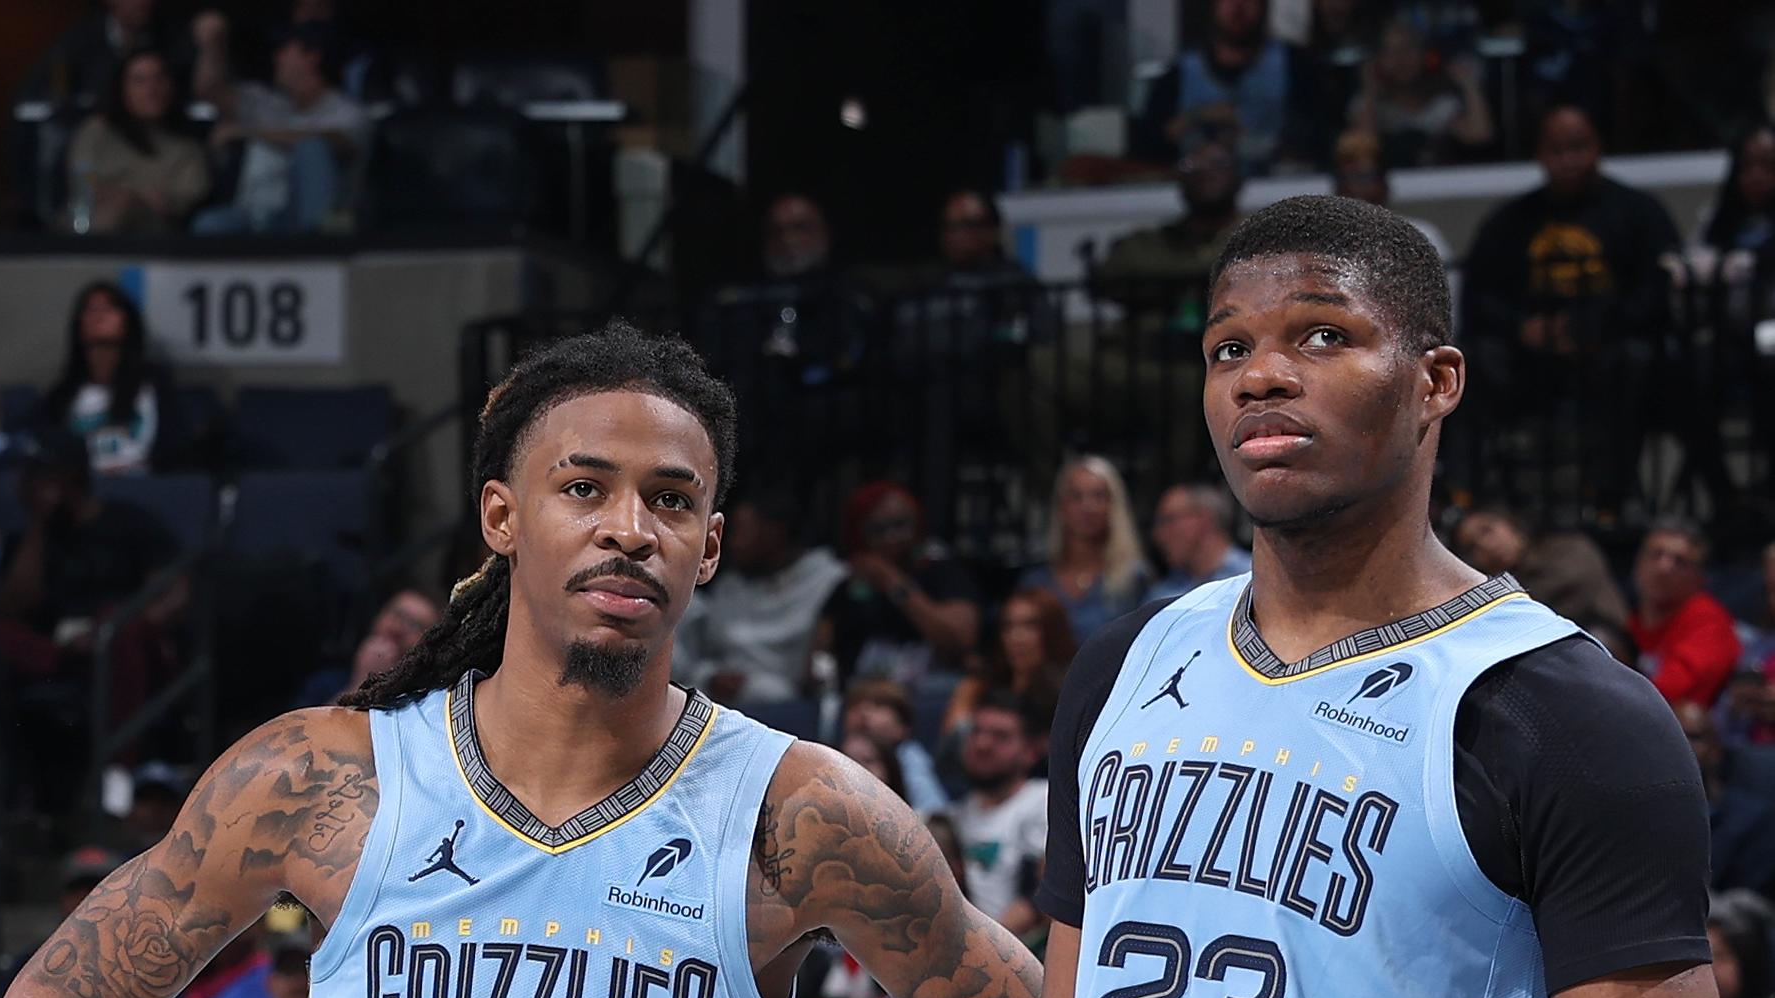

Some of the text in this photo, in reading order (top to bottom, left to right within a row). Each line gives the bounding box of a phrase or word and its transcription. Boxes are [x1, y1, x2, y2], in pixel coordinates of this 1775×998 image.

[183, 282, 308, 348] 108
[1314, 702, 1409, 743] Robinhood
[1086, 749, 1400, 938] GRIZZLIES
[607, 886, 705, 921] Robinhood
